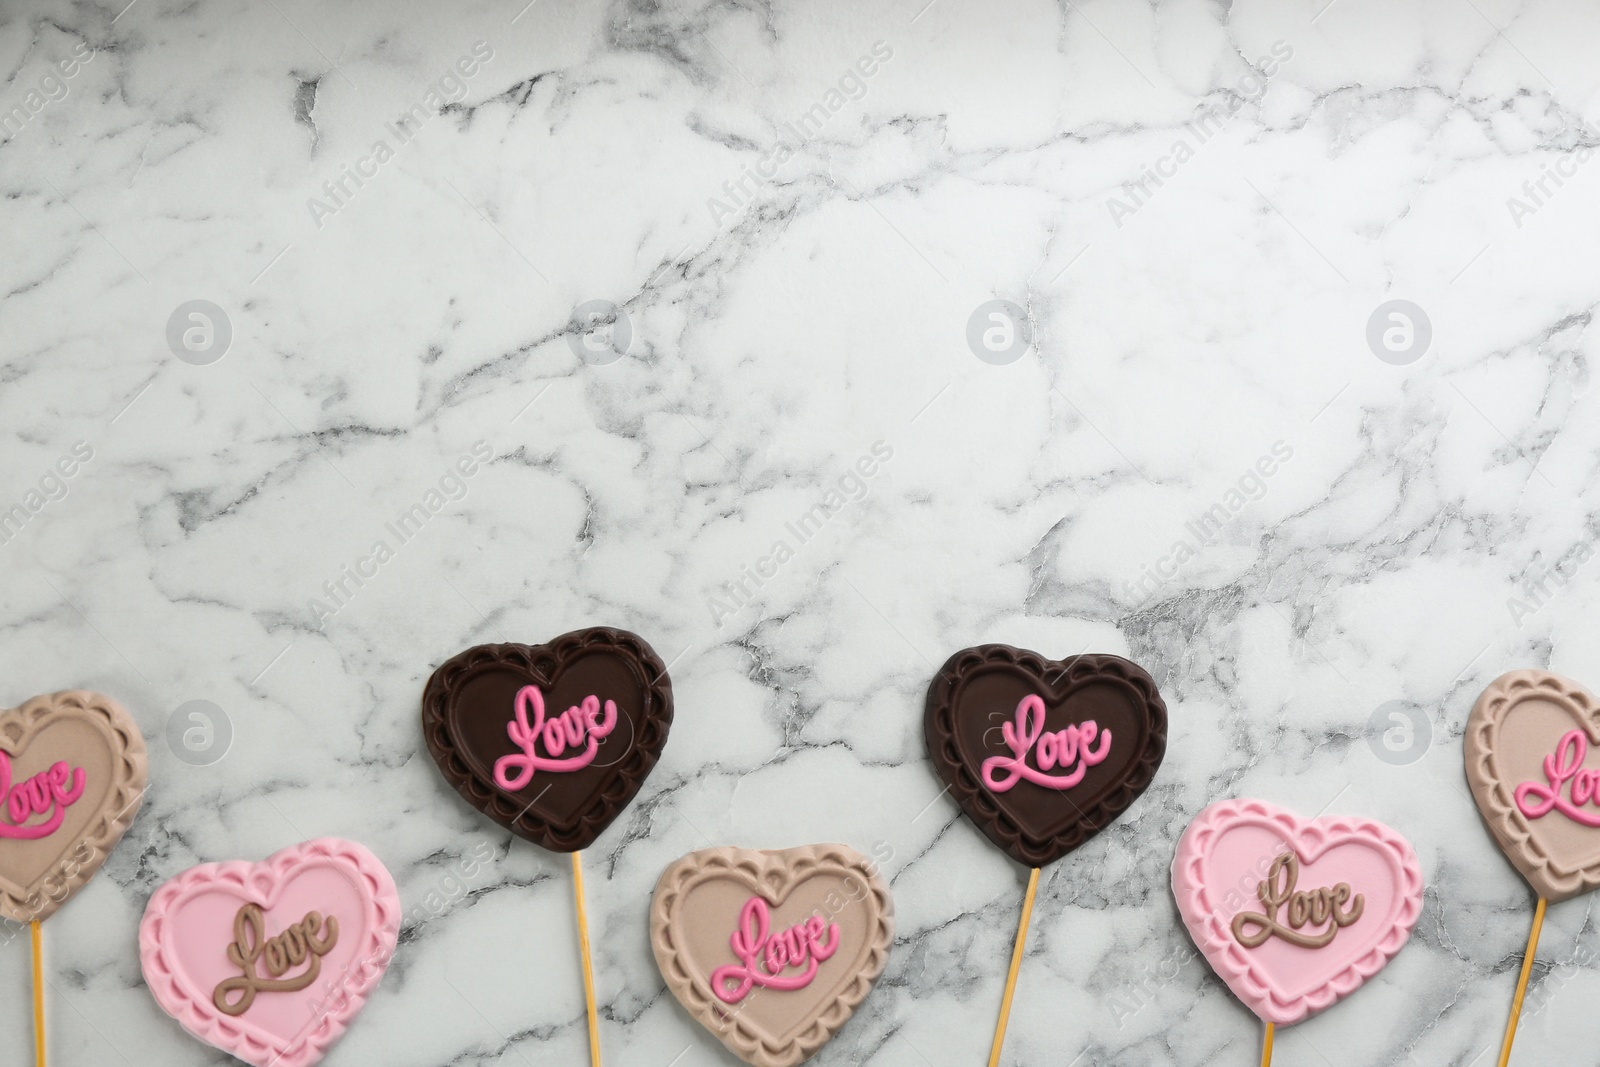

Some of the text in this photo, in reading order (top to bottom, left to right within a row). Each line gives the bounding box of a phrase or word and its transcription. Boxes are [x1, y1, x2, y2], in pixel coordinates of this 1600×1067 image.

[493, 684, 618, 791] Love
[981, 693, 1112, 793] Love
[711, 896, 840, 1004] Love
[1231, 851, 1365, 949] Love
[213, 902, 339, 1016] Love
